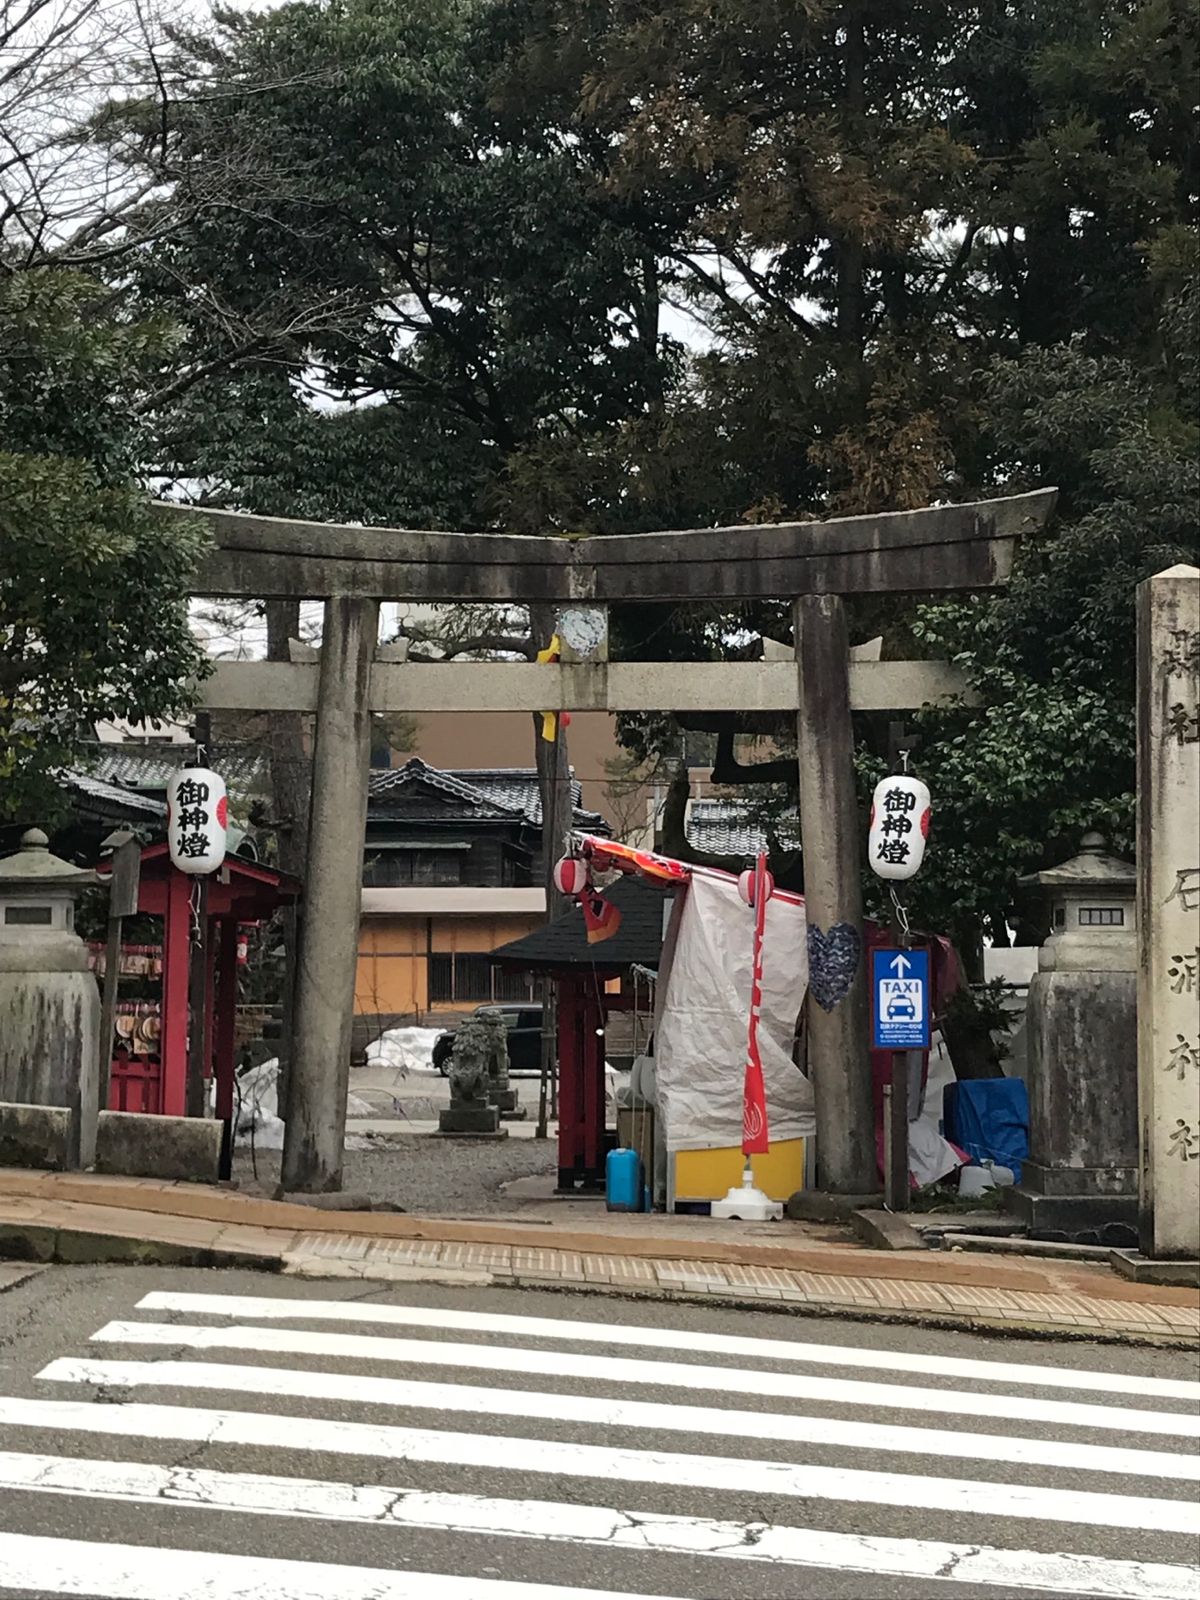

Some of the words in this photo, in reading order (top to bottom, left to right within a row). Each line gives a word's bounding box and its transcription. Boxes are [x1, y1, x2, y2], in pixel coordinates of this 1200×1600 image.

[176, 778, 211, 858] 御神燈
[876, 786, 917, 865] 御神燈
[883, 982, 919, 993] TAXI
